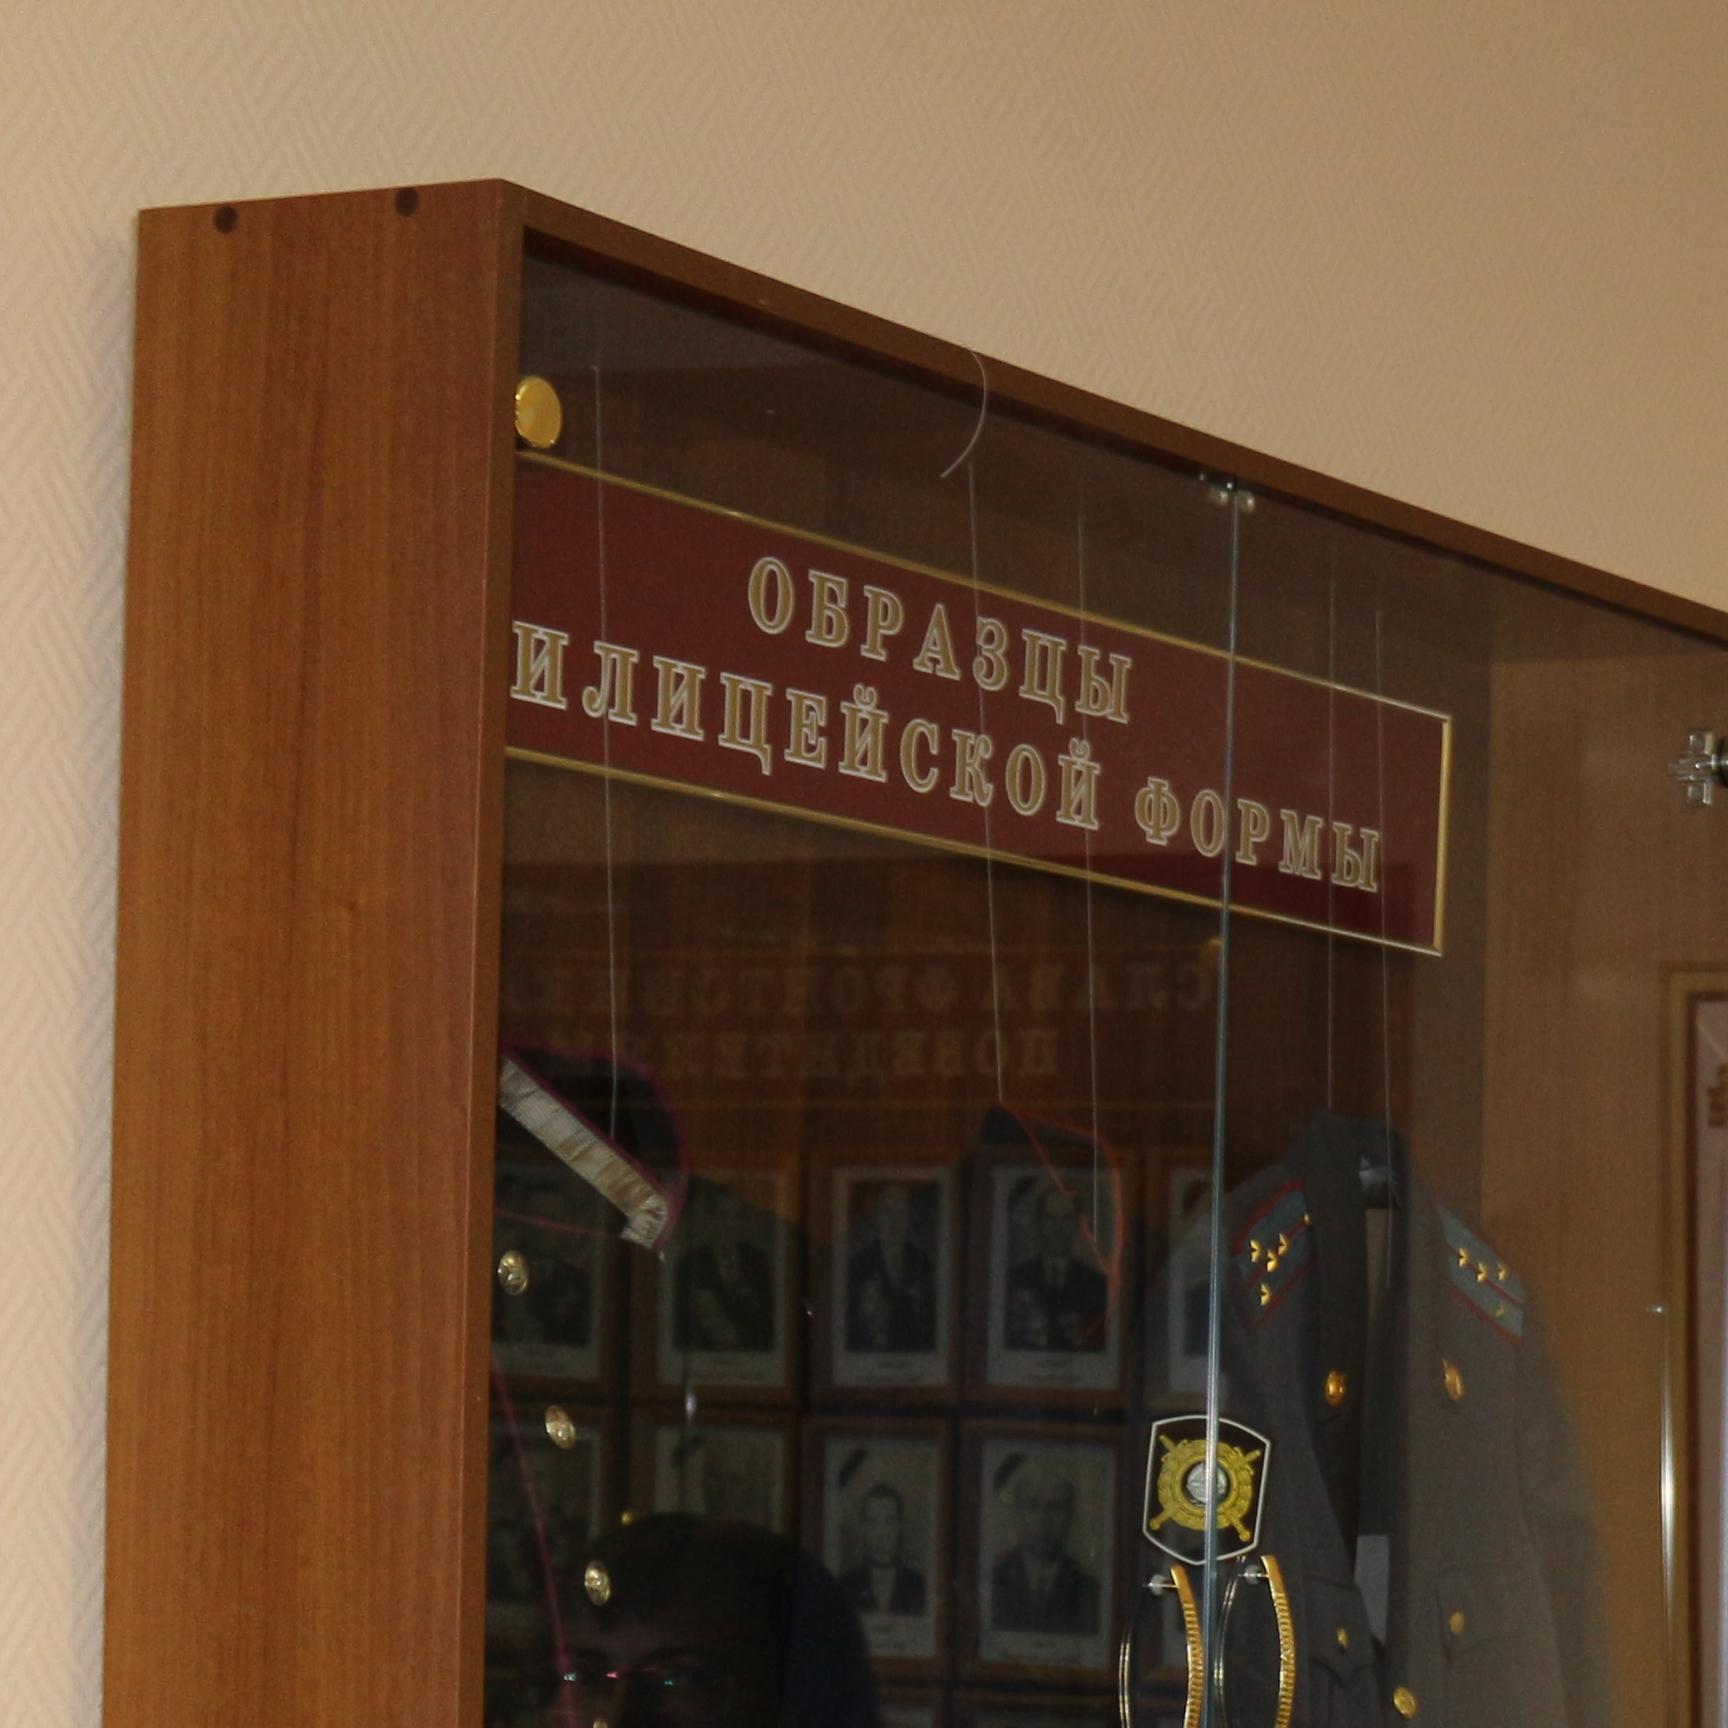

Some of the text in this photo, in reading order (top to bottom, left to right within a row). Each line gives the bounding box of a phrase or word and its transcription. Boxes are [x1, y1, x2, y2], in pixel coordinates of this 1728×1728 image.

[747, 554, 1132, 724] ОБРАЗЦЫ
[510, 619, 1382, 892] ИЛИЦЕЙСКОЙ ФОРМЫ
